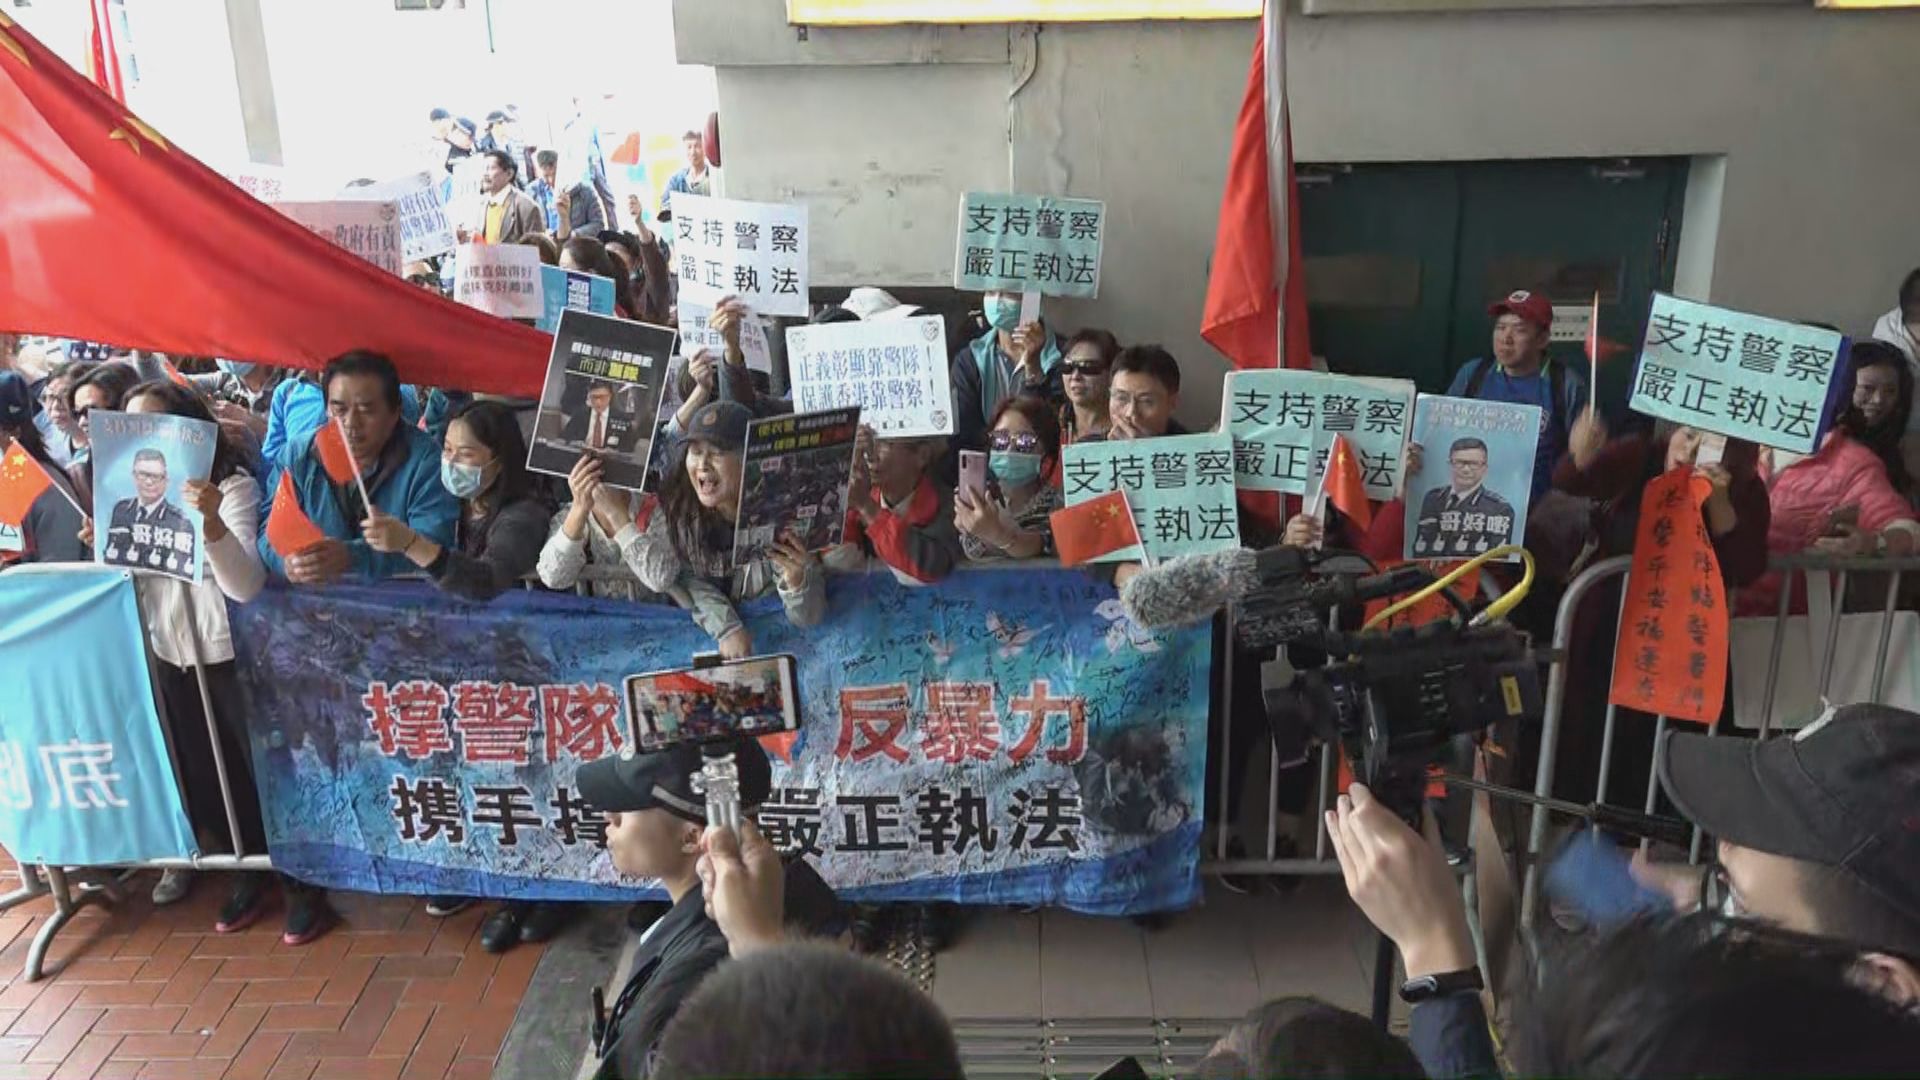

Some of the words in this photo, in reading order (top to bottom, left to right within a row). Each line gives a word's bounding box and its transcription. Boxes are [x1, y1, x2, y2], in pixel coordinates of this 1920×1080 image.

[676, 215, 799, 253] 支持警察
[966, 204, 1100, 240] 支持警察
[680, 254, 800, 295] 嚴正執法
[964, 246, 1095, 283] 嚴正執法
[1646, 313, 1834, 385] 支持警察
[1231, 388, 1406, 435] 支持警察
[1636, 362, 1817, 439] 嚴正執法
[1065, 449, 1234, 496] 支持警察
[1418, 510, 1511, 536] 一哥好嘢
[362, 680, 624, 765] 撐警隊
[834, 678, 1089, 765] 反暴力
[757, 786, 1082, 857] 嚴正執法
